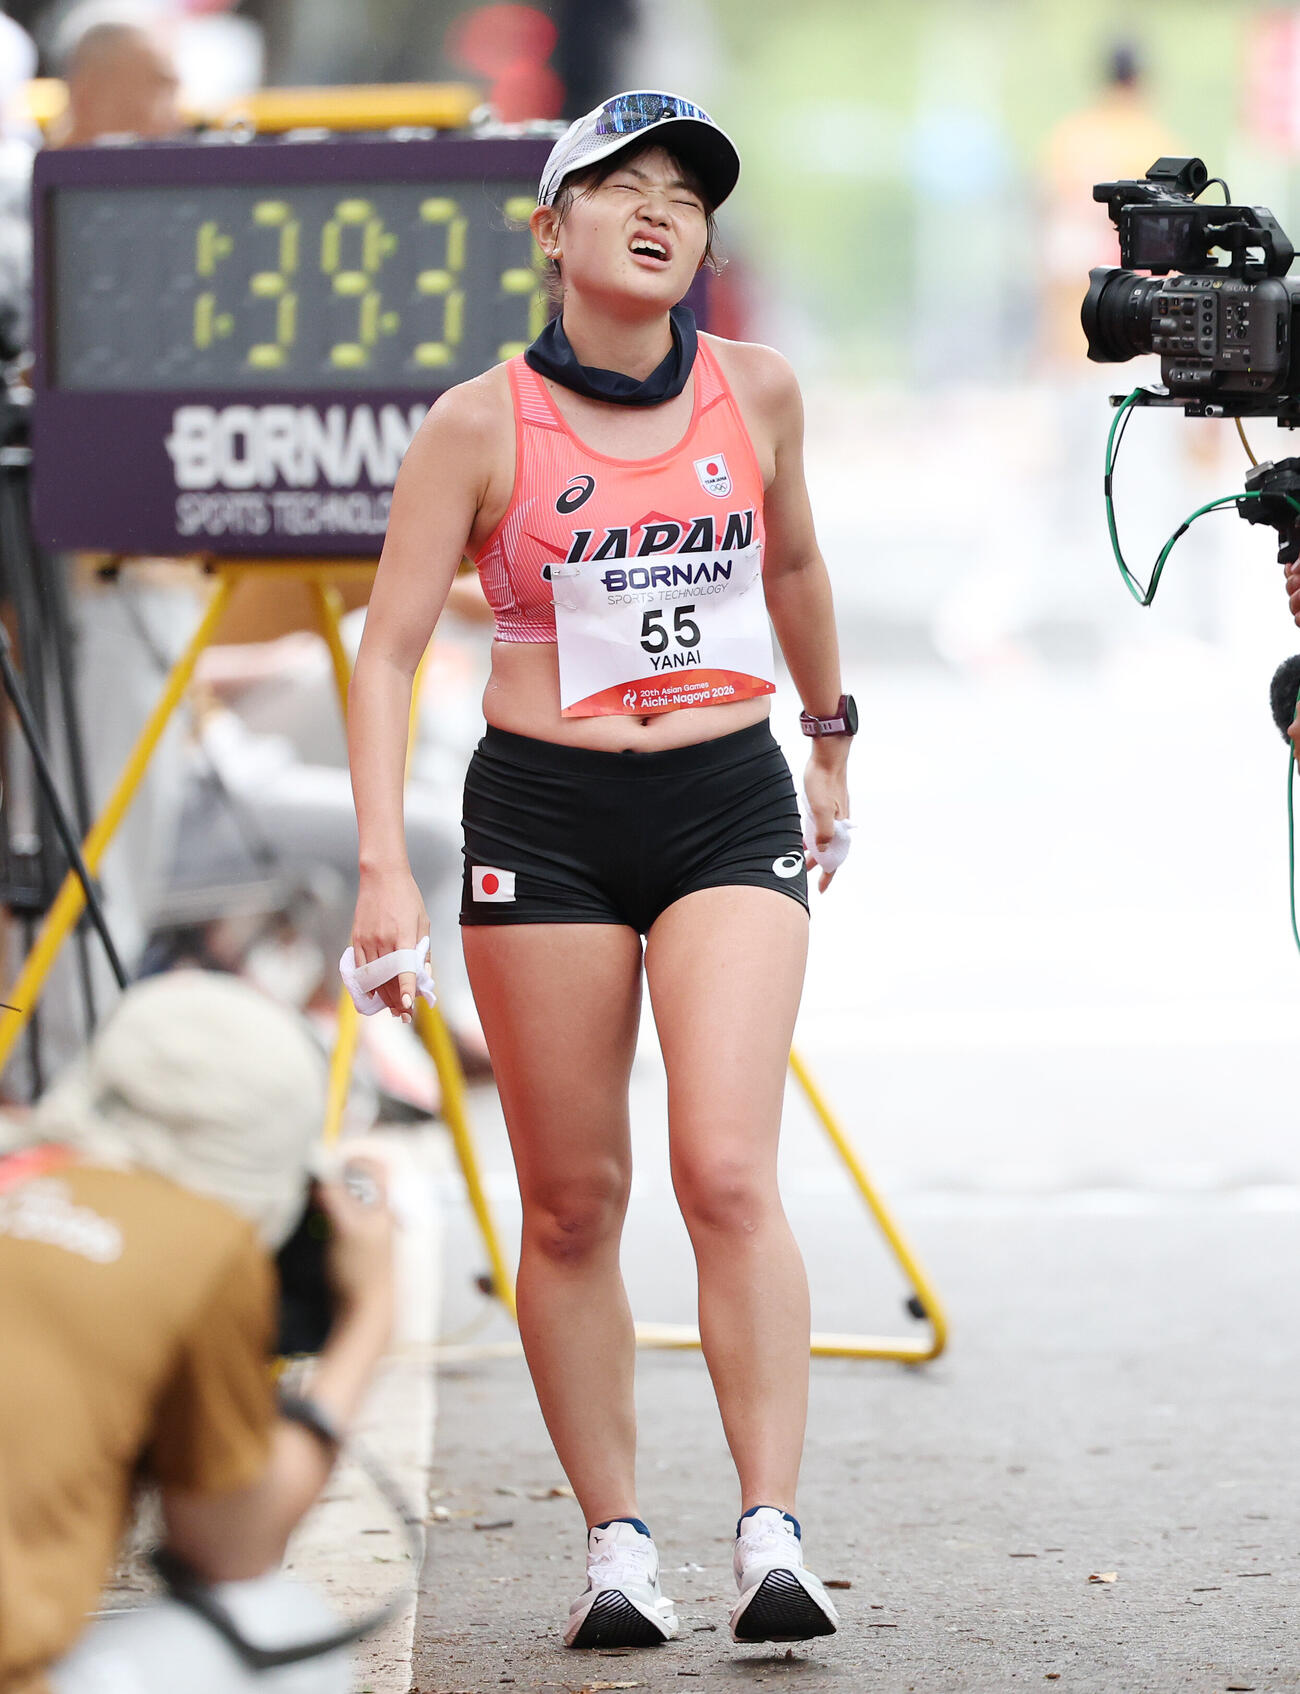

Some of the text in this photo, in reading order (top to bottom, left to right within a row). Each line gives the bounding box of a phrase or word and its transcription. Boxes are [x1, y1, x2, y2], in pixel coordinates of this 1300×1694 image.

[174, 491, 272, 536] SPORTS
[542, 510, 753, 581] JAPAN
[600, 559, 733, 592] BORNAN
[607, 582, 729, 606] SPORTS TECHNOLOGY
[640, 604, 701, 654] 55
[649, 650, 701, 671] YANAI
[640, 682, 710, 698] 20th Asian Games
[640, 685, 735, 708] Aichi-Nagoya 2026
